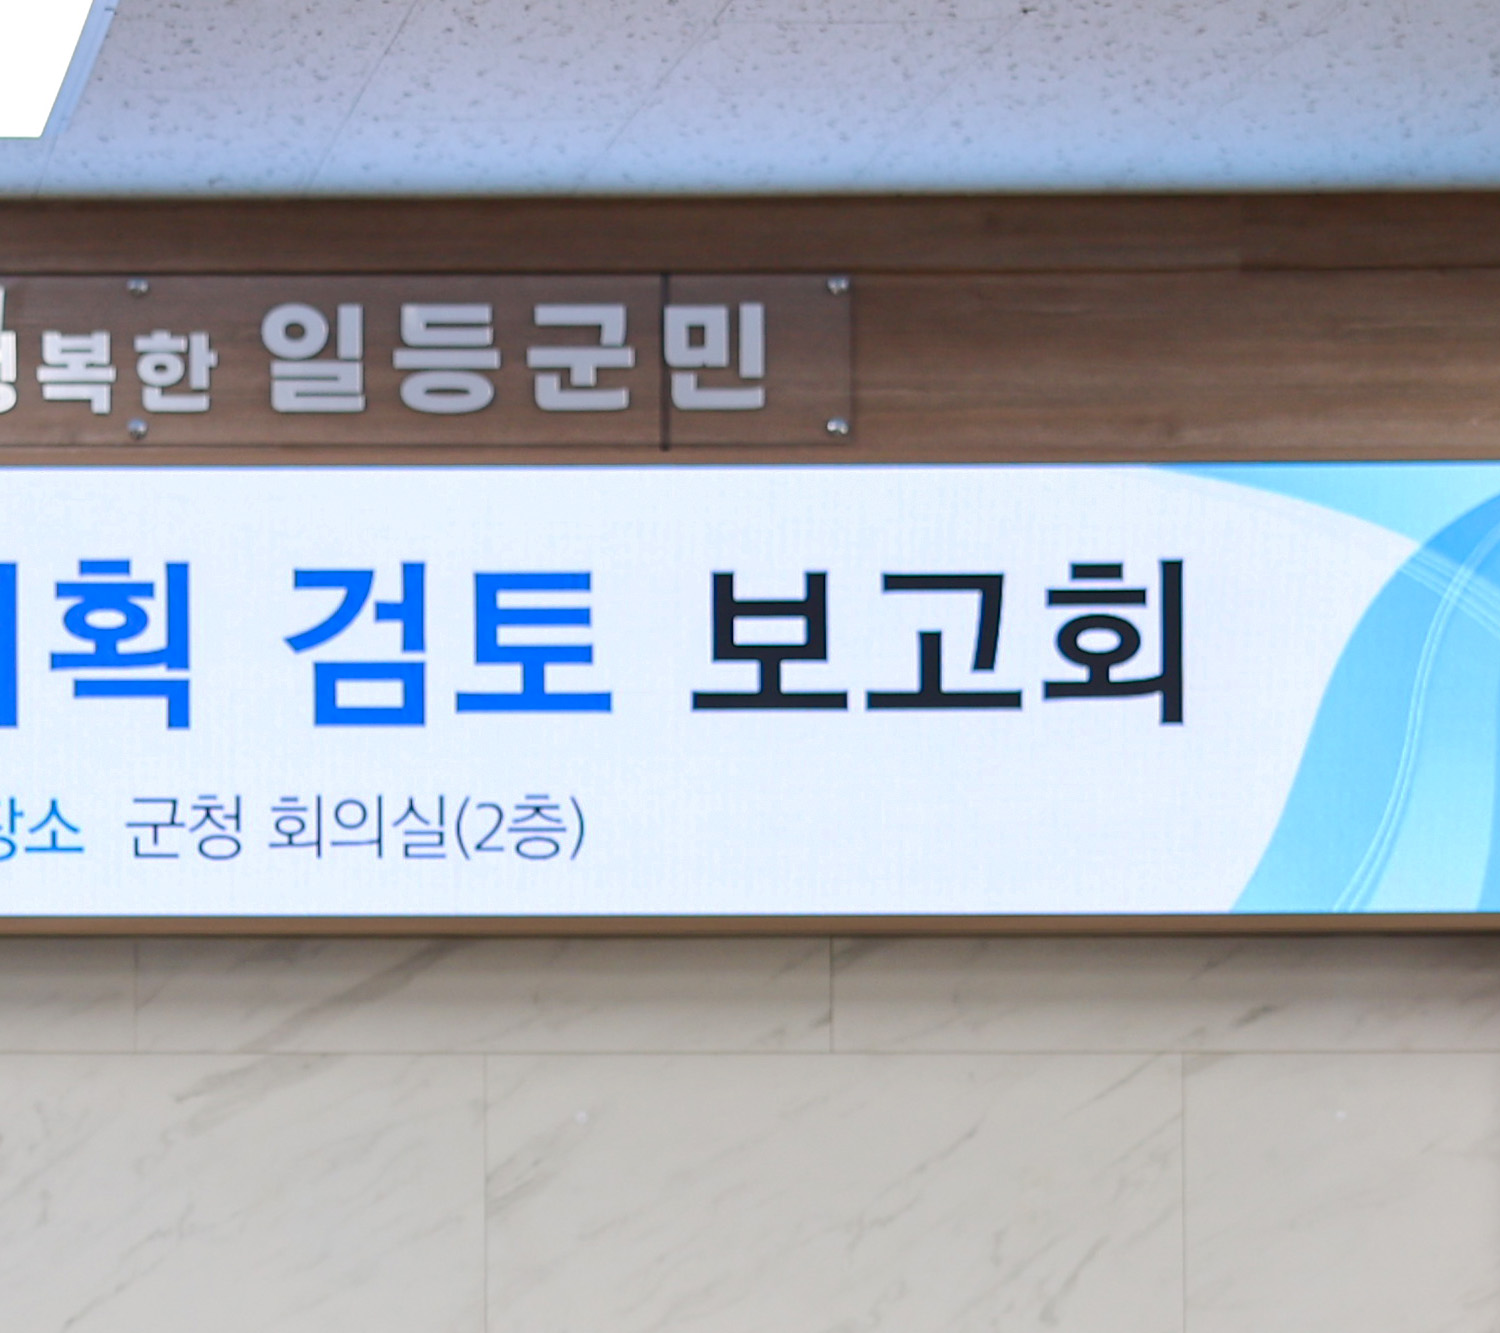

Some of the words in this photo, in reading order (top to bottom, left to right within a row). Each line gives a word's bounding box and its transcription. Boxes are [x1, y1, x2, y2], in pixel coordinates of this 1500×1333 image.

[261, 303, 765, 413] 일등군민
[284, 561, 613, 727] 검토
[691, 558, 1184, 726] 보고회
[125, 793, 243, 861] 군청
[267, 793, 586, 861] 회의실(2층)
